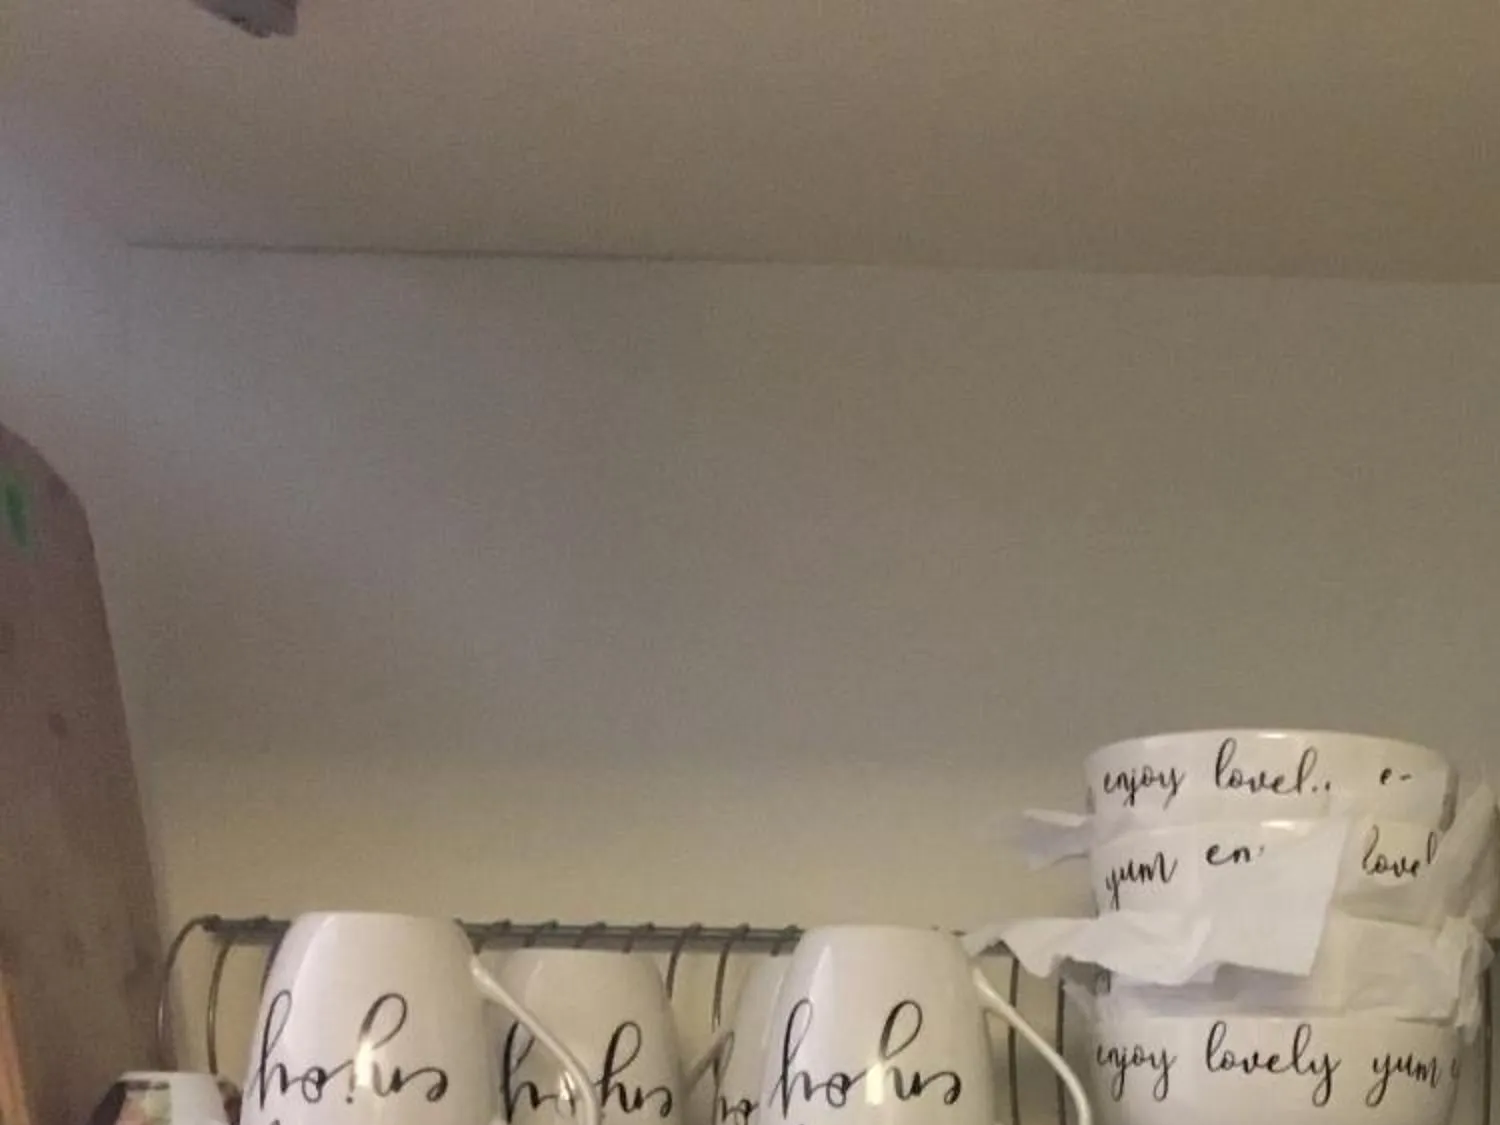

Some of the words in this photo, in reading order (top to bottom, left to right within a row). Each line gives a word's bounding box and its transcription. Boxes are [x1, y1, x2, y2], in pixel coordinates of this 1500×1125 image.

[1102, 762, 1186, 811] enjoy
[1213, 736, 1332, 796] lovel
[1104, 851, 1179, 911] yum
[1361, 823, 1439, 878] lovel
[254, 989, 450, 1110] enjoy
[769, 998, 963, 1119] enjoy
[1204, 1020, 1343, 1108] lovely
[1364, 1050, 1442, 1109] yum
